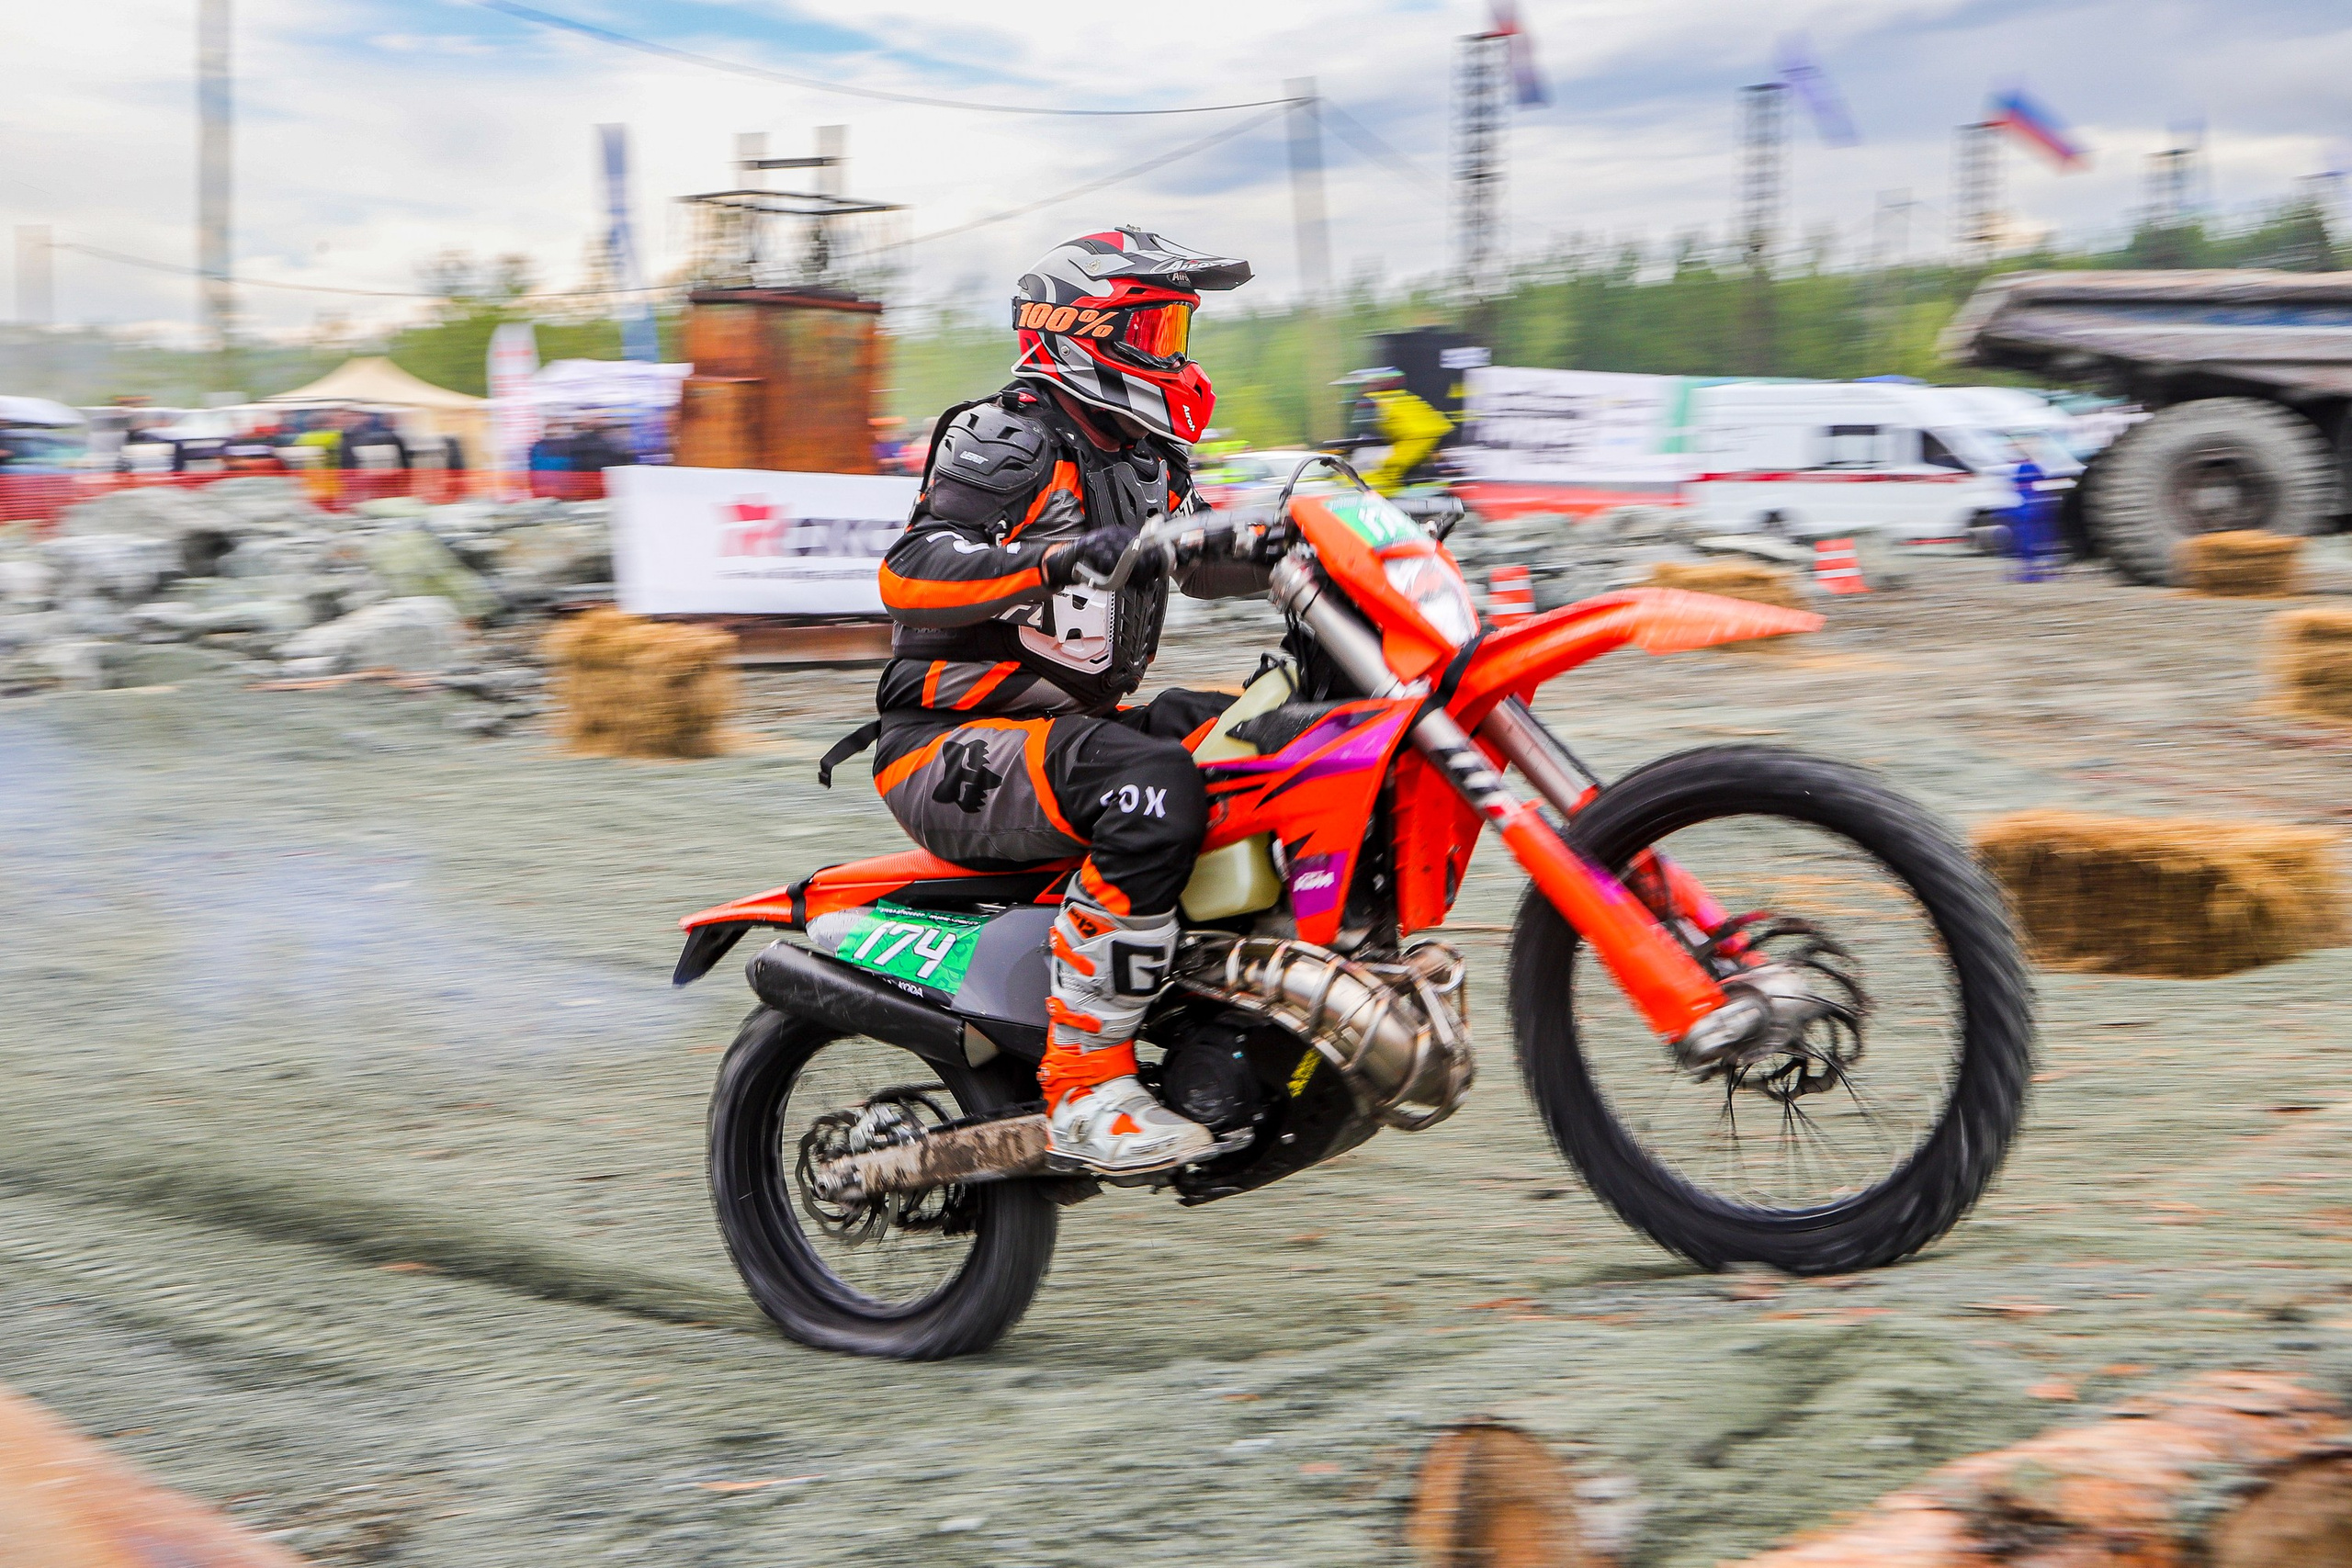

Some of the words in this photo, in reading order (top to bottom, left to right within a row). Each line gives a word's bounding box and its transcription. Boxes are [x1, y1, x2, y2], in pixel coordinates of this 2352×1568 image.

[1018, 302, 1119, 338] 100%
[1182, 404, 1196, 432] Airoh
[1293, 870, 1335, 893] KTM
[853, 920, 957, 979] 174
